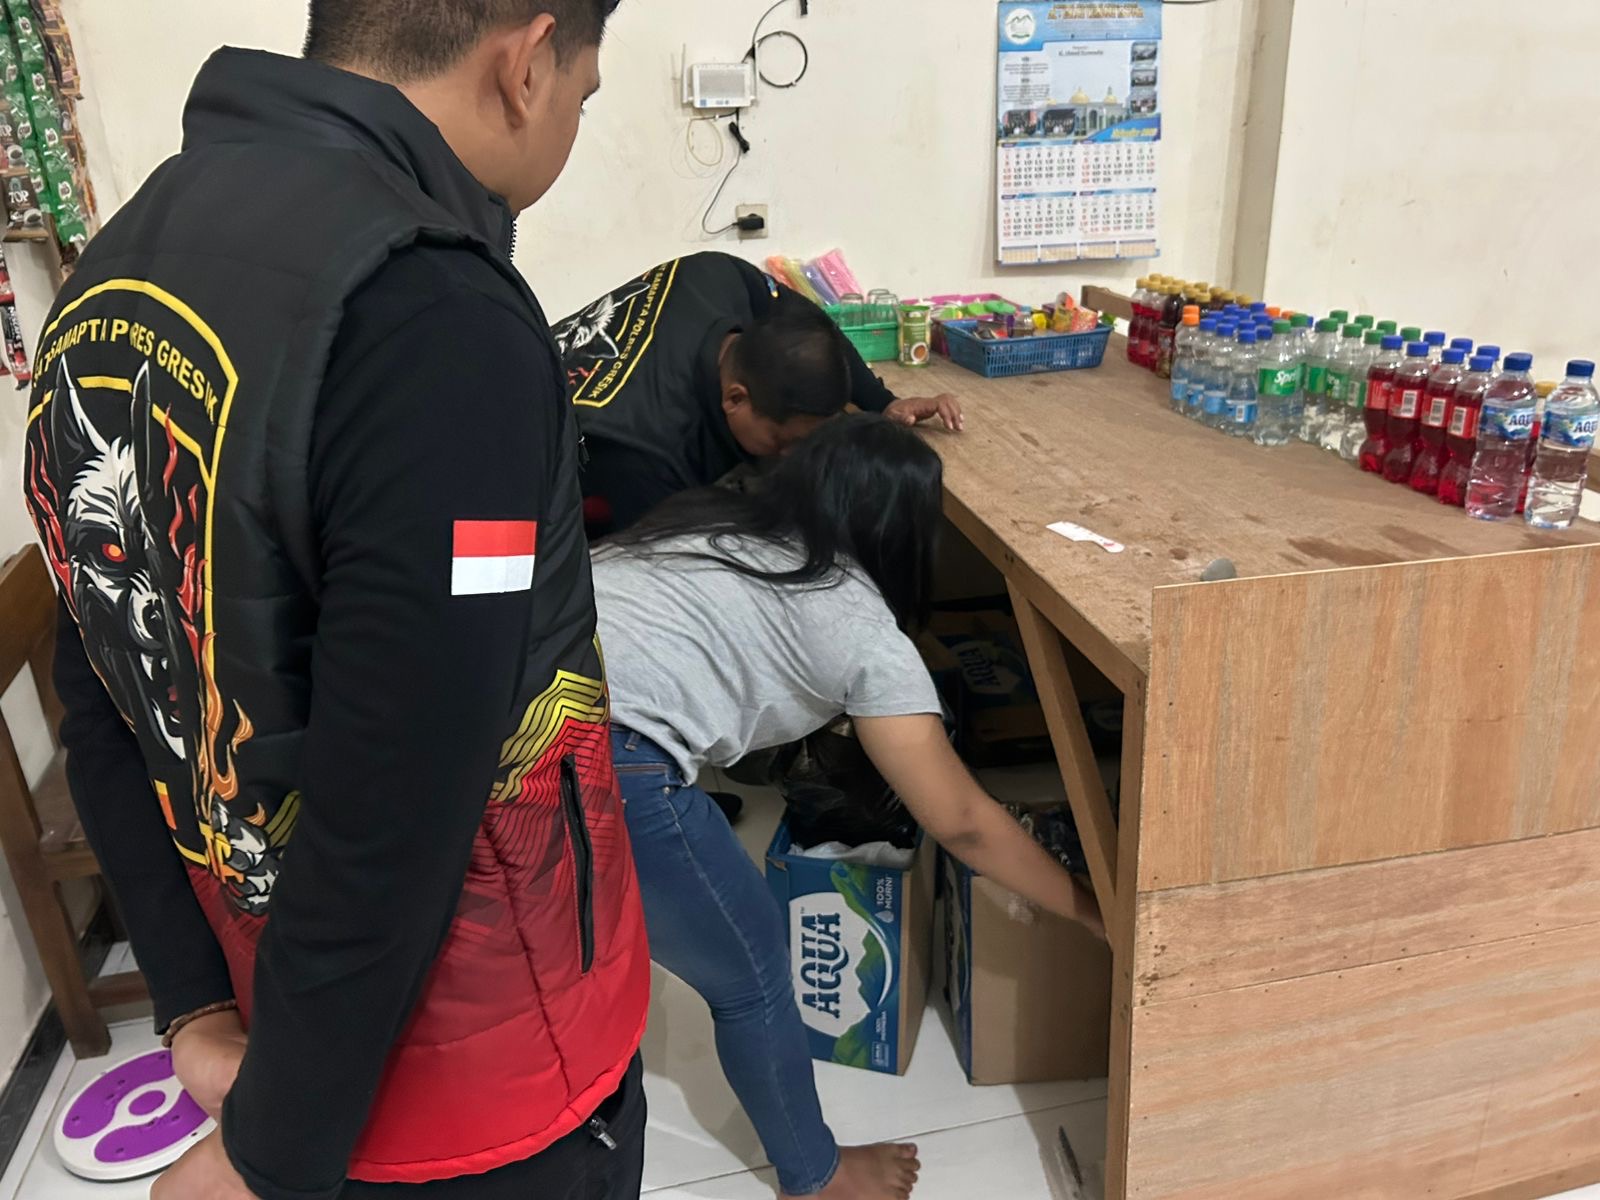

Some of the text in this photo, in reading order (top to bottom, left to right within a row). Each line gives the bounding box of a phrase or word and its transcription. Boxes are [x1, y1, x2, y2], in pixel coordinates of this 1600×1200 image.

[8, 190, 29, 203] TOP
[588, 360, 623, 398] GRESIK
[876, 878, 884, 905] 100%
[885, 876, 893, 909] MURNI
[801, 912, 849, 1019] AQUA
